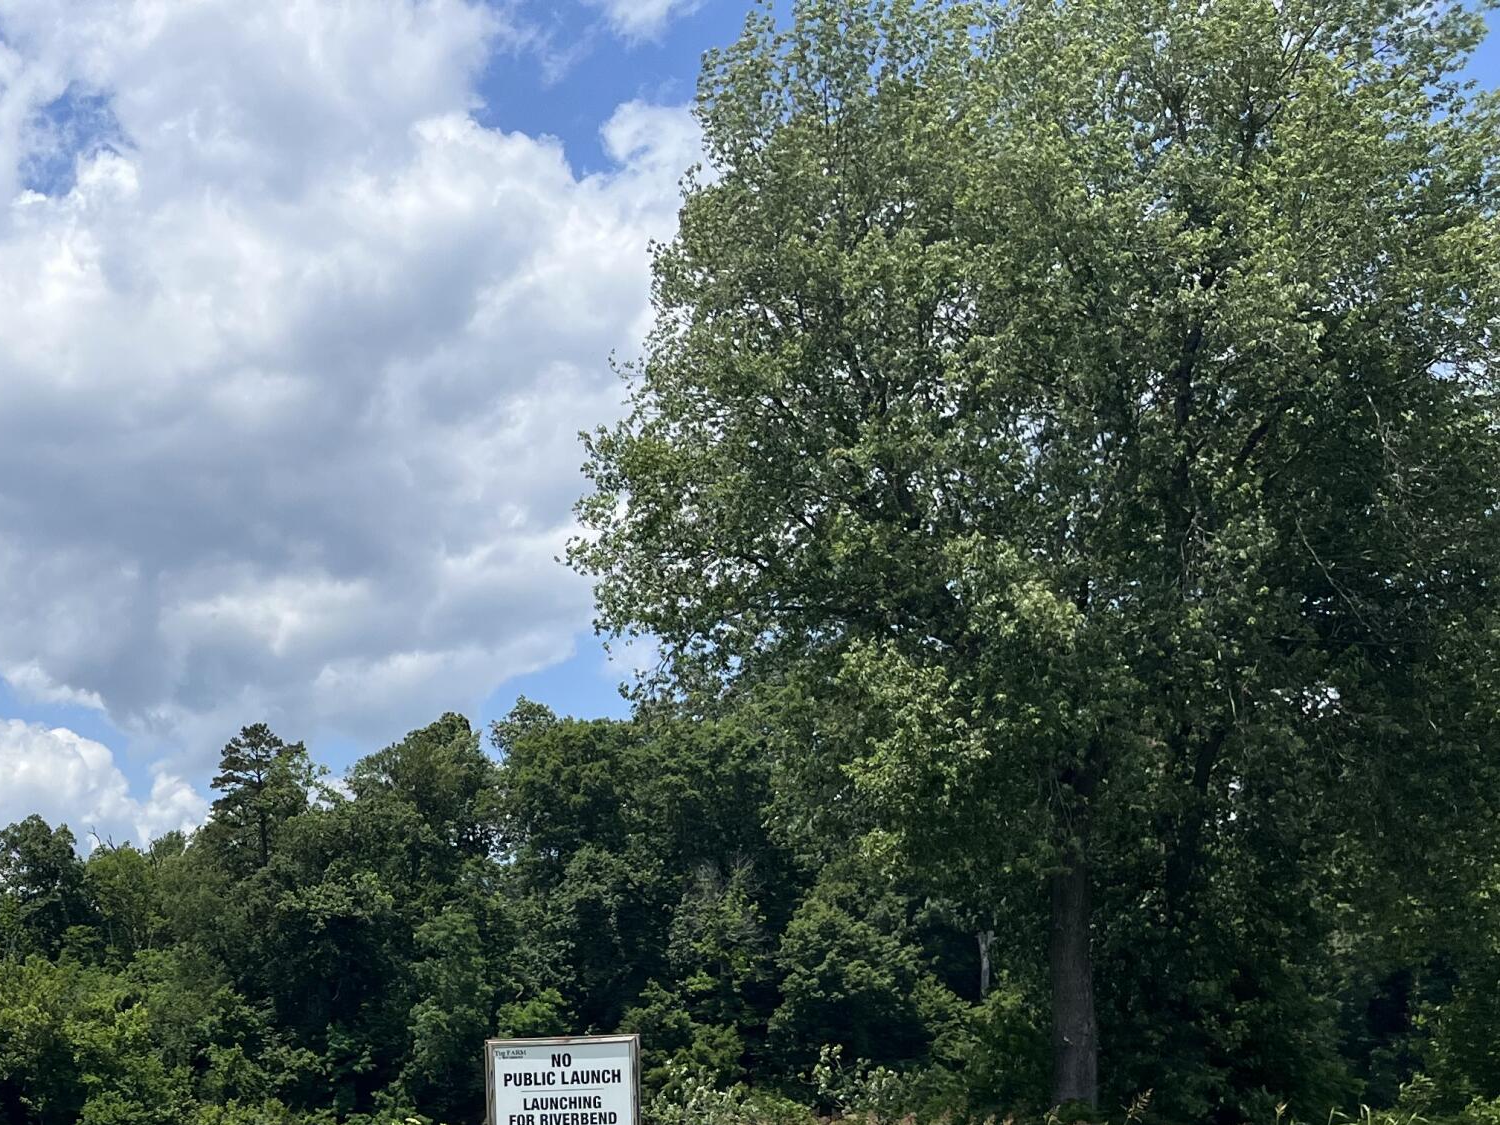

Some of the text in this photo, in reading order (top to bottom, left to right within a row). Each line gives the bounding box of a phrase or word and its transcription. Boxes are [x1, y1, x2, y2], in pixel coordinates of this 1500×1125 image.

[551, 1053, 572, 1067] NO
[503, 1069, 621, 1087] PUBLIC LAUNCH
[523, 1096, 602, 1111] LAUNCHING
[540, 1112, 617, 1125] RIVERBEND
